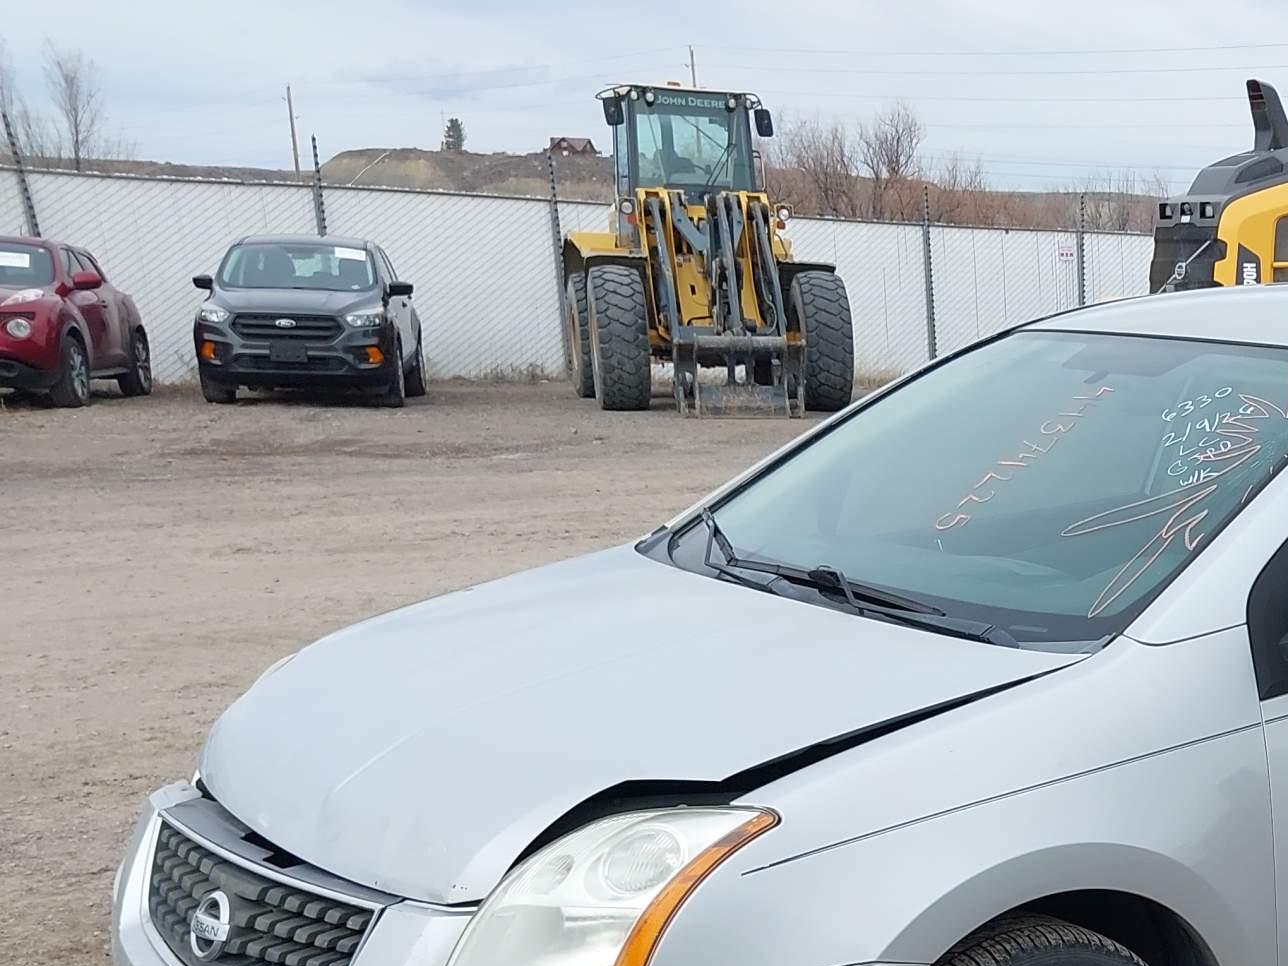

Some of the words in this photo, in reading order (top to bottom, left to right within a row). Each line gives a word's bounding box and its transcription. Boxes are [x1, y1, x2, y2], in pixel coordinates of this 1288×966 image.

[656, 95, 687, 106] JOHN
[688, 97, 727, 109] DEERE
[1161, 387, 1232, 422] 6330
[193, 916, 220, 937] SSAN
